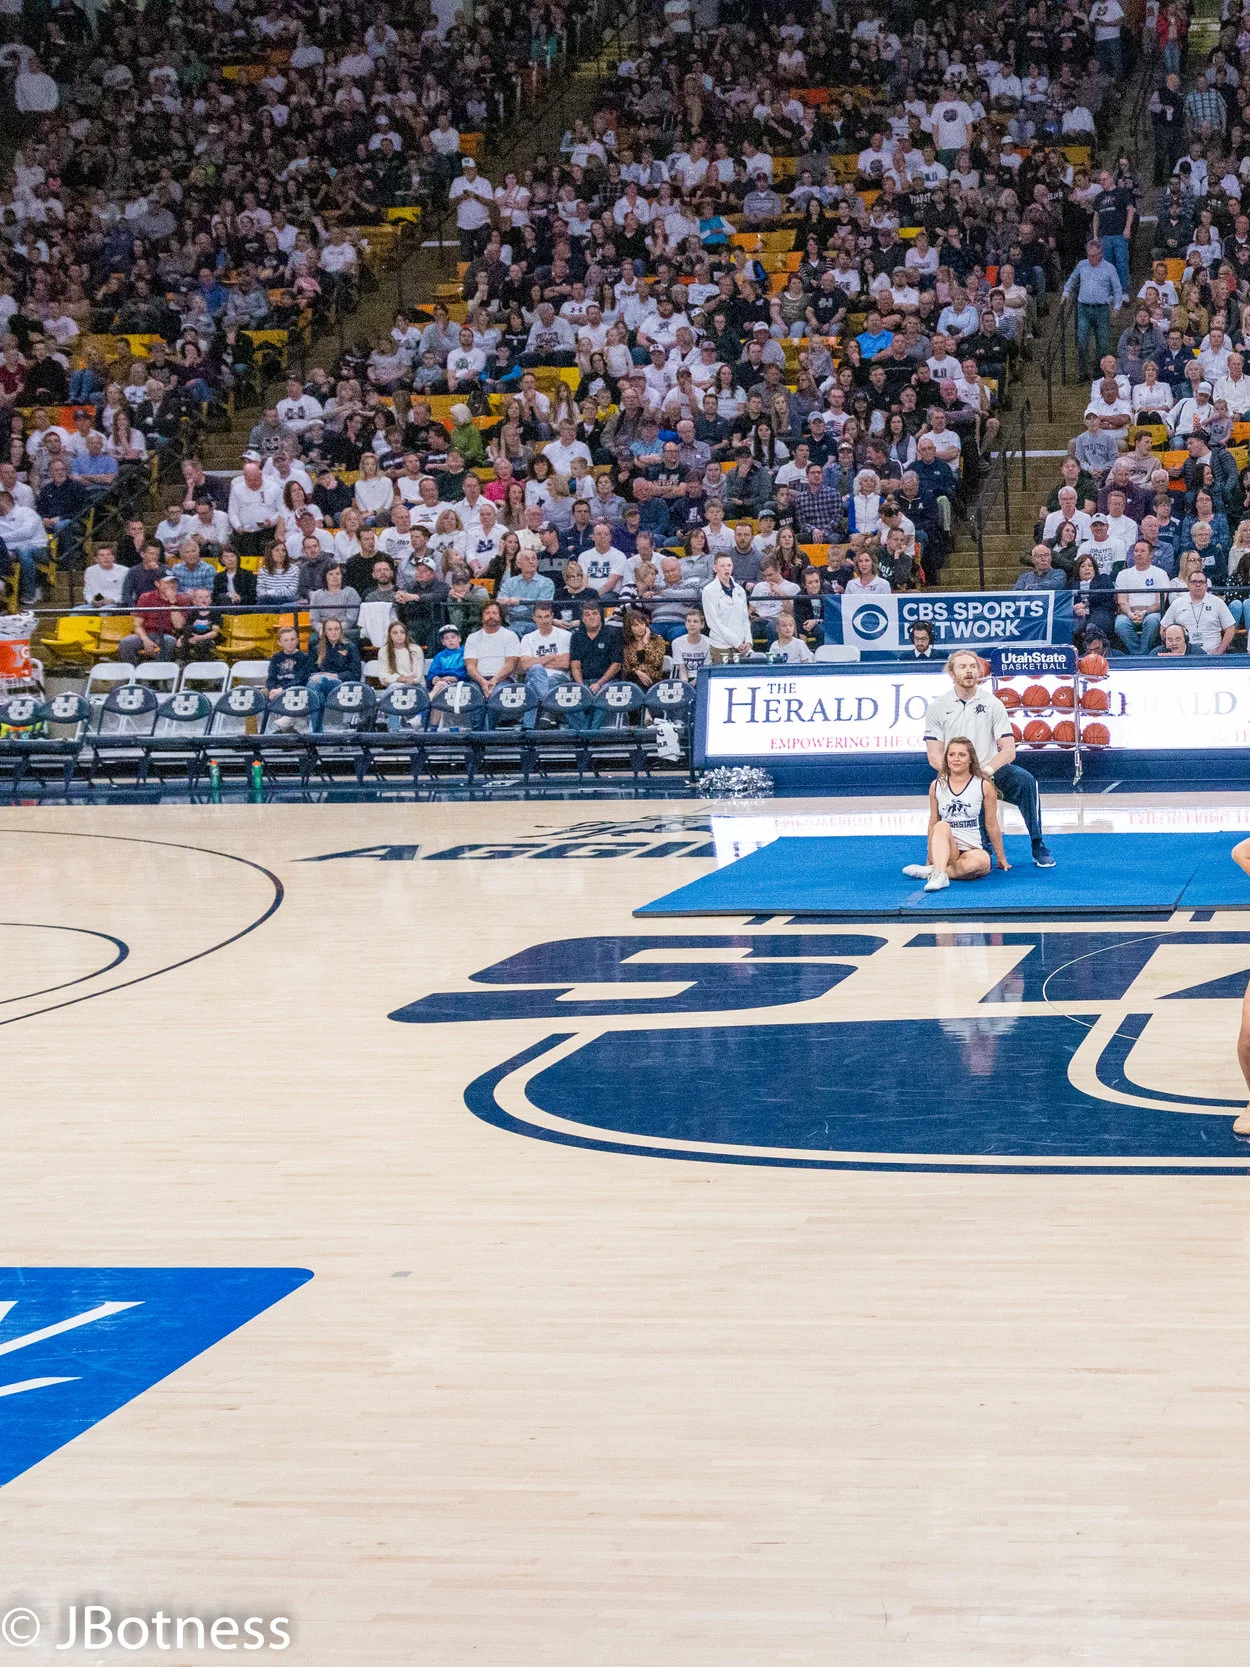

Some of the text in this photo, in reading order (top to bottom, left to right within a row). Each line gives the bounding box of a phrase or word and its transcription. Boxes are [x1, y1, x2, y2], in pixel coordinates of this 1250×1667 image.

[902, 600, 1044, 621] CBS SPORTS
[904, 619, 1021, 640] NTWORK
[1002, 652, 1067, 664] UtahState
[1002, 663, 1068, 671] BASKETBALL
[767, 683, 797, 694] THE
[723, 687, 879, 724] HERALD
[770, 736, 870, 750] EMPOWERING
[875, 736, 902, 748] THE
[290, 842, 717, 861] AGGI
